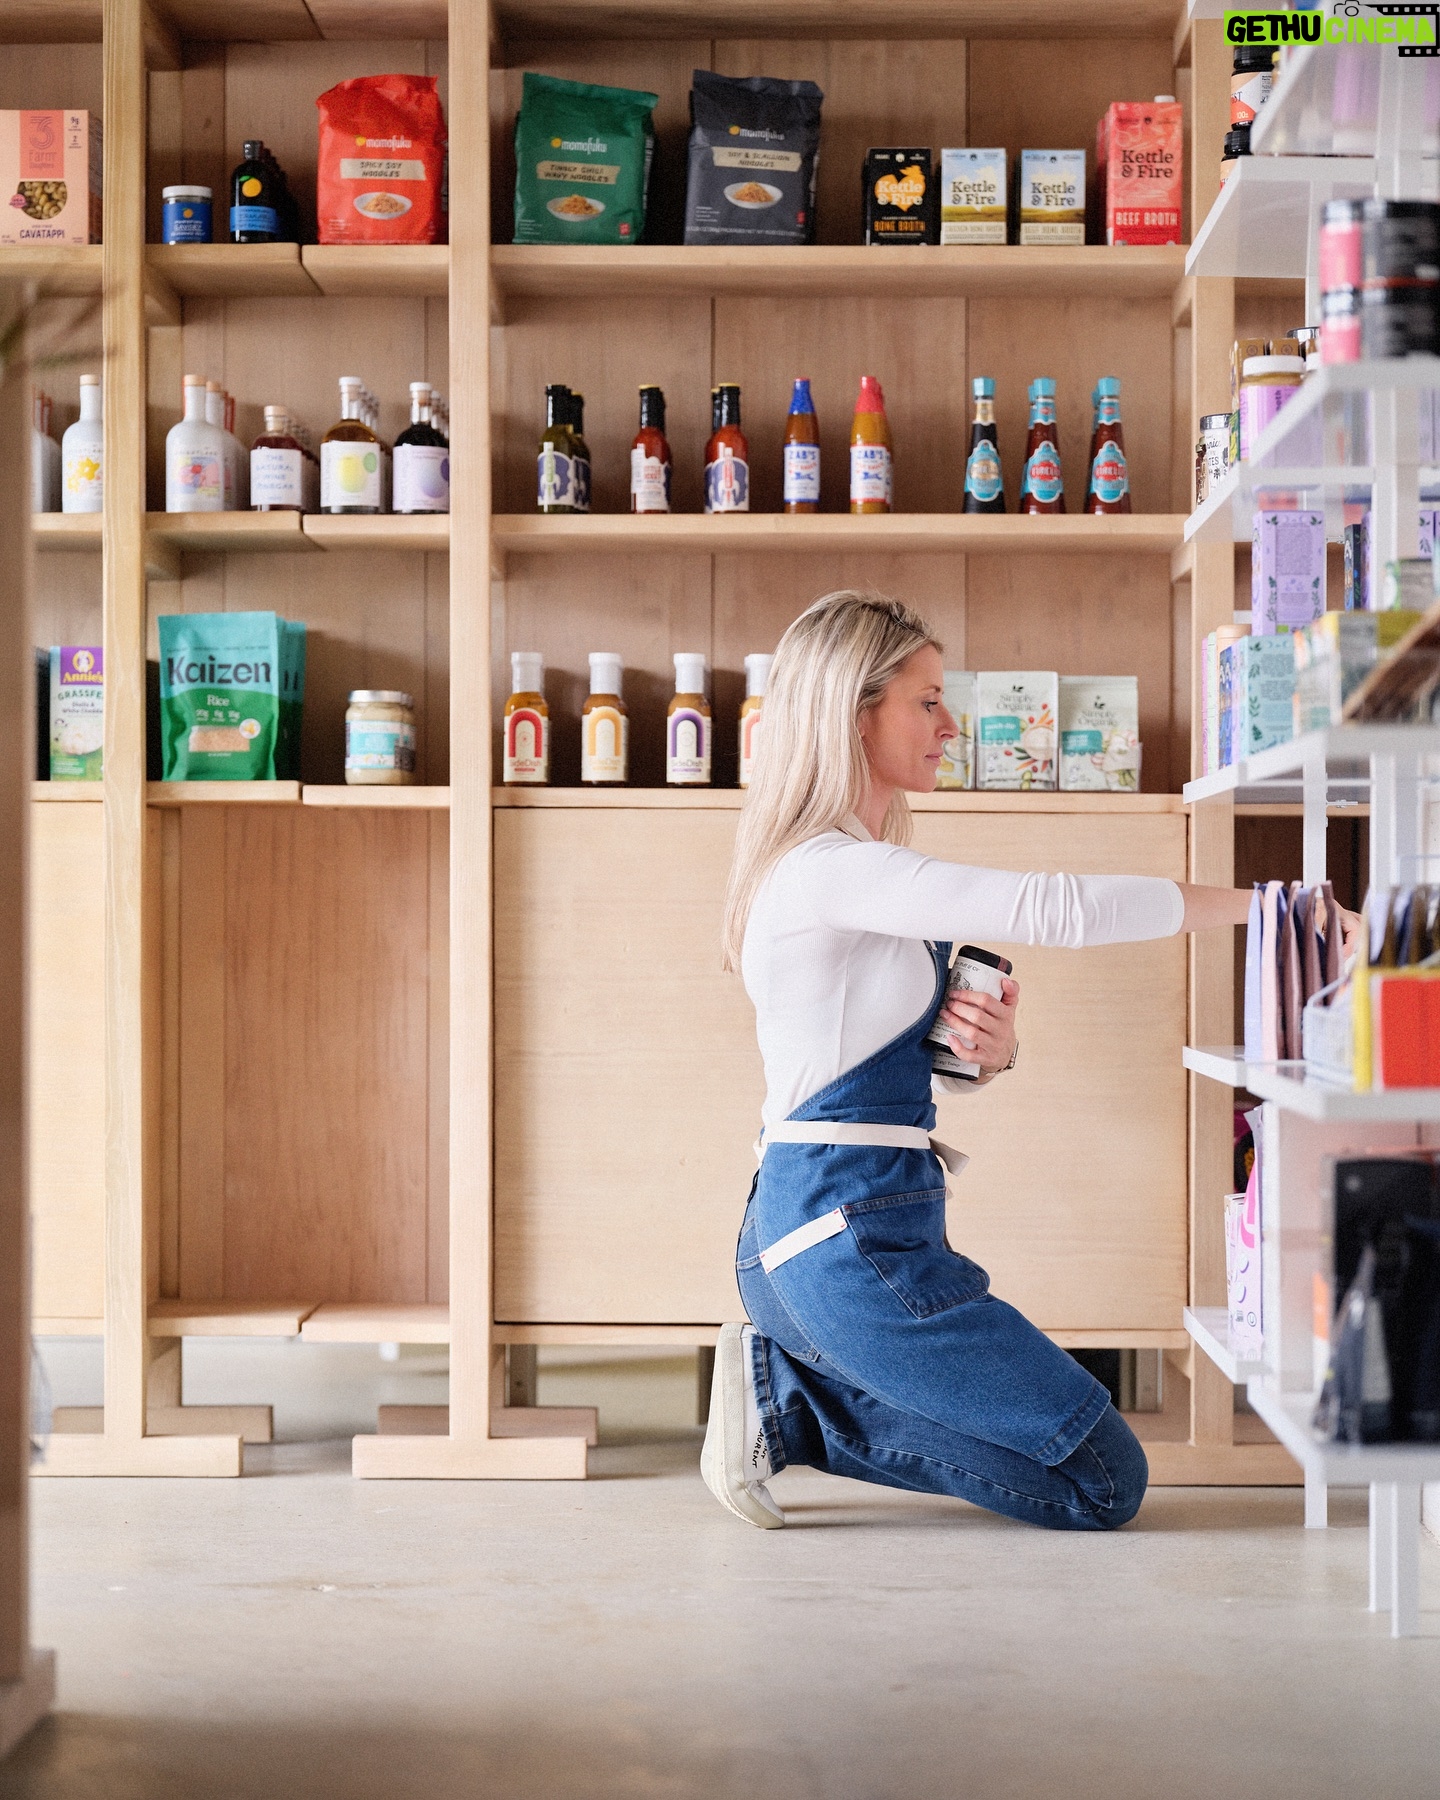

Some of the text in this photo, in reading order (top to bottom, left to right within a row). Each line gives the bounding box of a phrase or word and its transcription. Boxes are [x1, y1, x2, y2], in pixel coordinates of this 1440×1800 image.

[740, 128, 785, 142] momofuku
[366, 135, 412, 152] momofuku
[561, 137, 608, 155] momofuku
[1122, 149, 1173, 164] Kettle
[1122, 164, 1173, 178] & Fire
[570, 175, 608, 183] NOODLES
[878, 180, 923, 193] Kettle
[952, 181, 996, 193] Kettle
[1031, 182, 1076, 194] Kettle
[877, 193, 923, 205] & Fire
[952, 193, 996, 205] & Fire
[1031, 194, 1076, 206] & Fire
[1115, 212, 1178, 226] BEEF BROTH
[874, 221, 926, 232] BONE BROTH
[20, 229, 65, 239] CAVATAPPI
[167, 655, 271, 686] Kaizen
[58, 689, 103, 701] GRASSFE
[207, 694, 230, 707] Rice
[1000, 694, 1033, 703] Simply
[996, 702, 1036, 712] Organic
